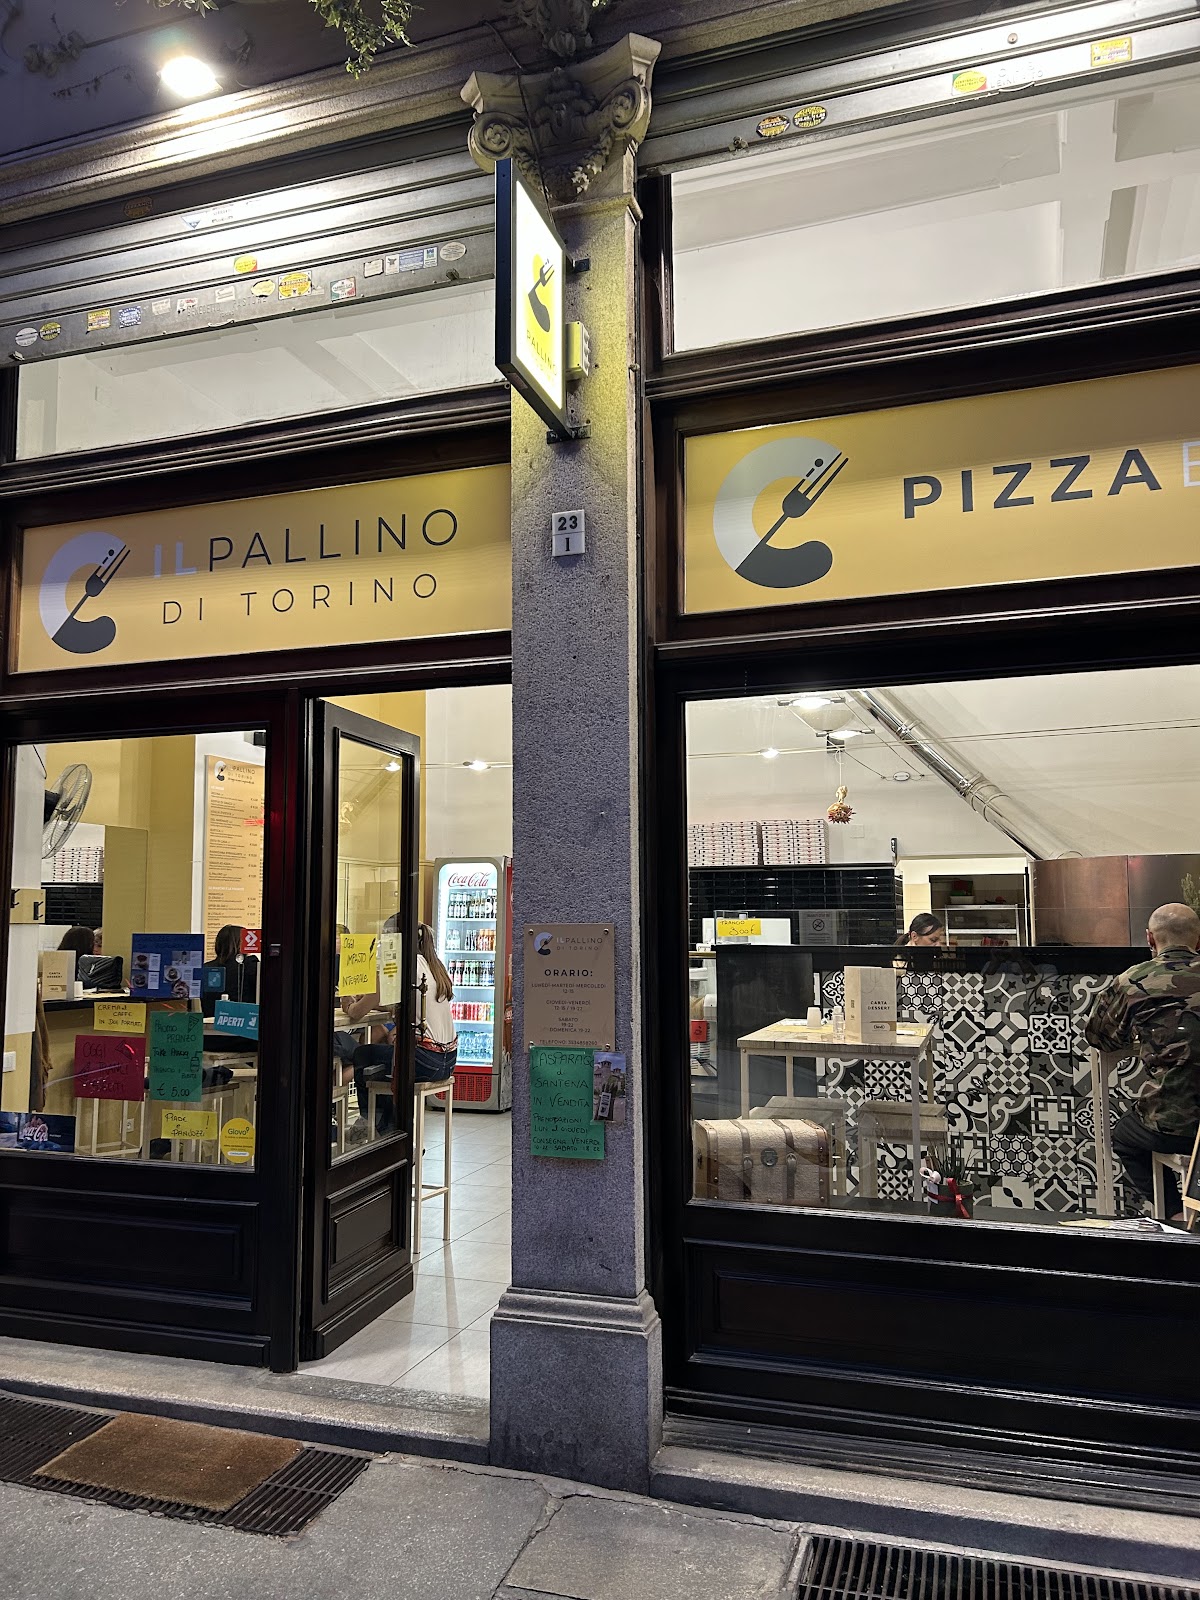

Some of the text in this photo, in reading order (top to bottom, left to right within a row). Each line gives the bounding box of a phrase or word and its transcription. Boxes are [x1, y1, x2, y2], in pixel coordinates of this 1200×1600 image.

[903, 448, 1162, 519] PIZZA
[557, 515, 578, 531] 23
[162, 573, 438, 625] DI TORINO
[544, 969, 593, 977] ORARIO:
[217, 1015, 245, 1028] APERTI
[534, 1077, 589, 1089] SANTENA
[533, 1096, 542, 1106] IN
[549, 1092, 590, 1108] VENDITA
[227, 1127, 248, 1136] Glovo
[532, 1136, 567, 1145] CONSEGNA
